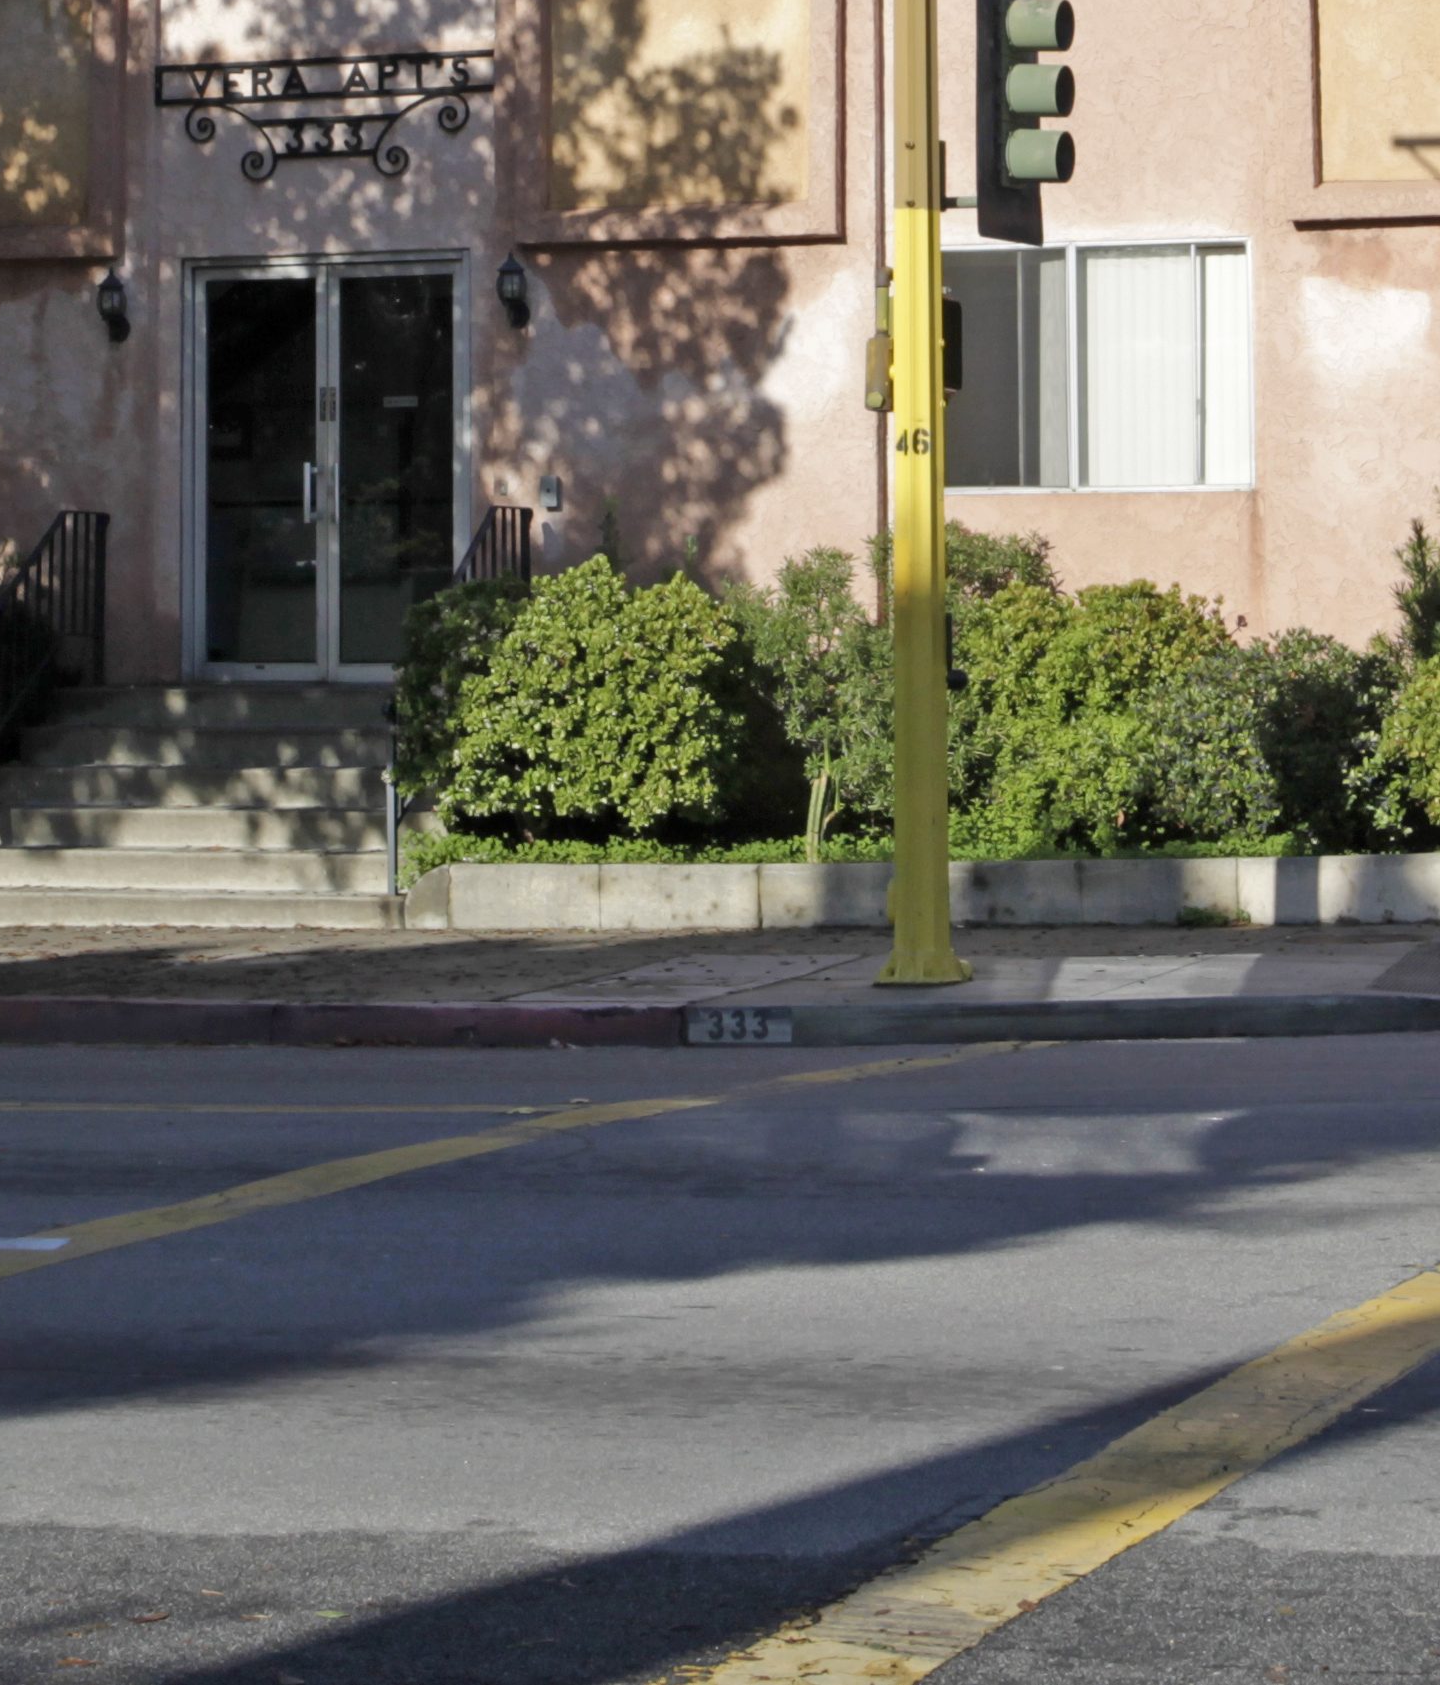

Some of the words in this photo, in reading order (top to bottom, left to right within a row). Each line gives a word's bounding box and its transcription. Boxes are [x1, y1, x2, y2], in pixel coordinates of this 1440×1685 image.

[189, 64, 309, 98] VERA
[341, 57, 471, 93] APT'S
[285, 120, 364, 153] 333
[896, 428, 929, 456] 46
[708, 1009, 769, 1040] 333
